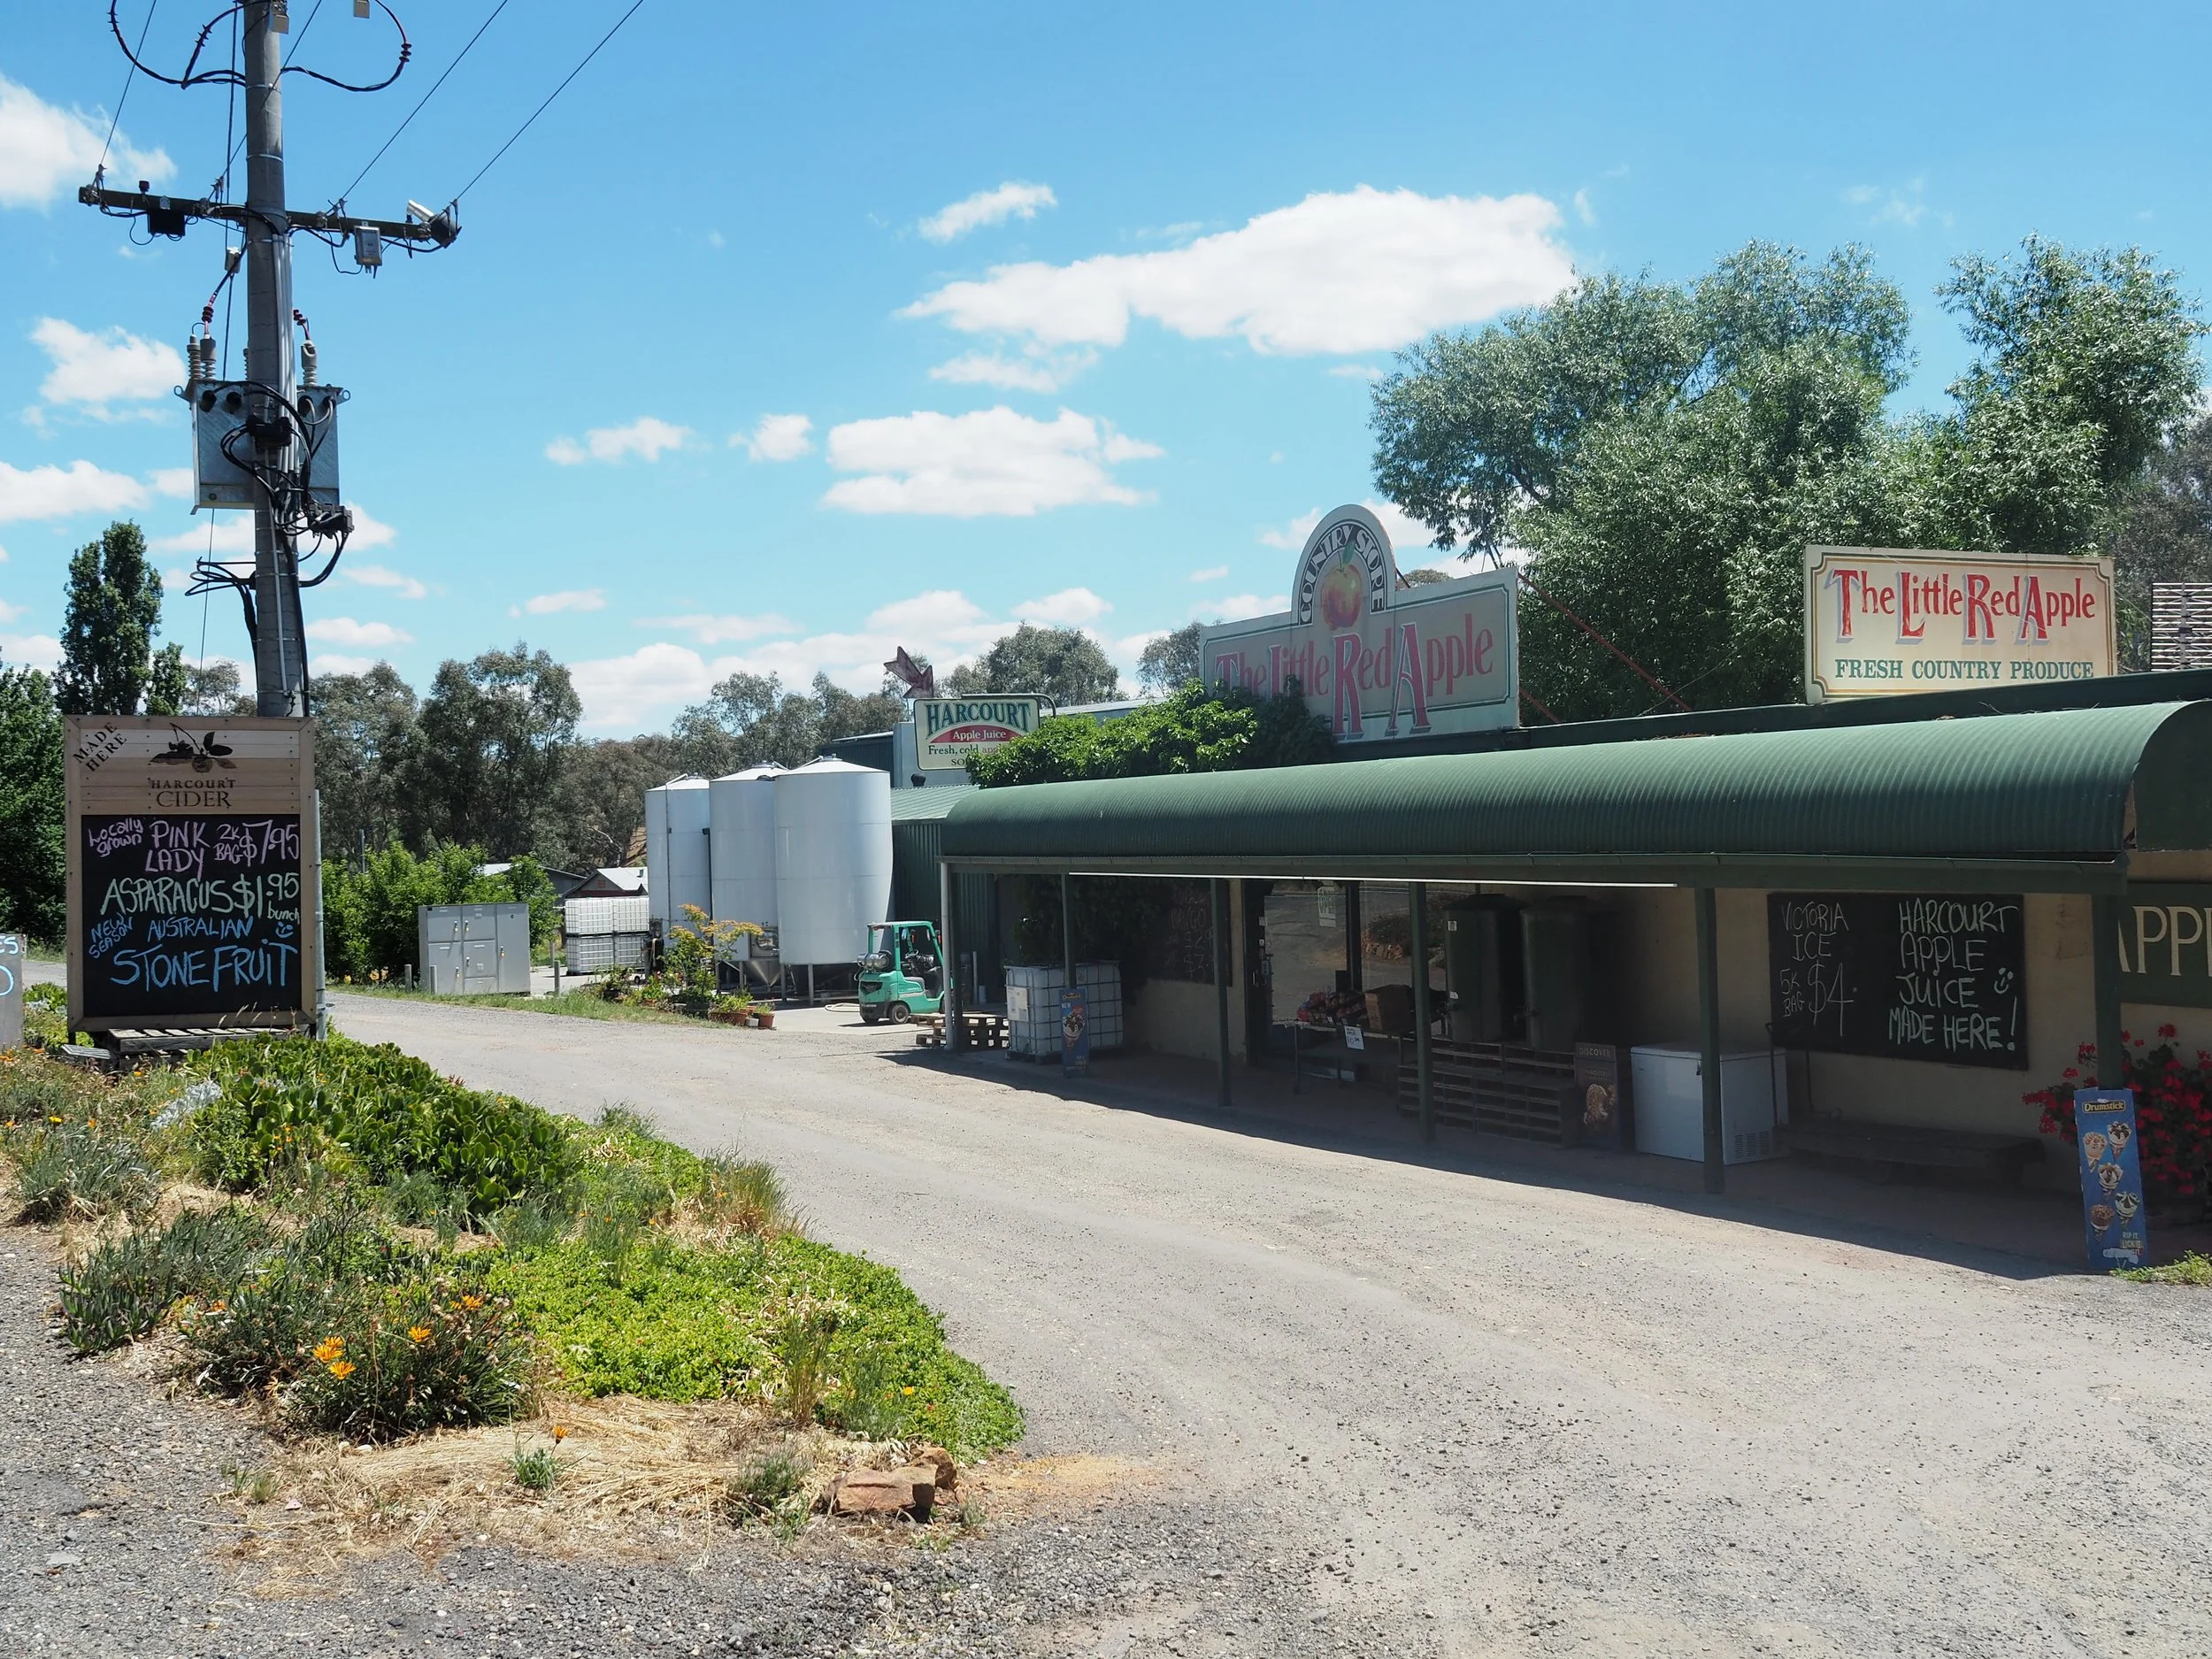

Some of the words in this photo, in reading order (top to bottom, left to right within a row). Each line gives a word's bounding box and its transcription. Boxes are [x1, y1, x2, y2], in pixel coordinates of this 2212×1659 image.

[1301, 525, 1353, 622] COUNTRY
[1355, 528, 1385, 611] STORE
[1826, 570, 1894, 637] The
[1901, 572, 1962, 637] Little
[1966, 574, 2019, 638] Red
[2021, 576, 2095, 639] Apple
[1333, 627, 1393, 738] Red
[1386, 613, 1494, 734] Apple
[1835, 659, 1902, 679] FRESH
[1911, 660, 2001, 680] COUNTRY
[2009, 661, 2093, 680] PRODUCE
[925, 703, 1033, 738] HARCOURT
[953, 730, 979, 741] Apple
[982, 729, 1006, 740] Juice
[73, 721, 118, 764] MADE
[86, 733, 127, 772] HERE
[928, 745, 957, 755] Fresh,
[959, 744, 979, 754] cold
[150, 780, 236, 789] HARCOURT
[156, 791, 232, 808] CIDER
[96, 833, 142, 857] grown
[145, 847, 204, 882] LADY
[213, 842, 245, 864] BAG
[149, 820, 211, 849] PINK
[217, 824, 241, 840] 2K
[239, 819, 300, 867] $7.95
[232, 872, 300, 918] $1.95
[266, 901, 300, 925] bunch
[147, 915, 253, 942] AUSTRALIAN
[1781, 902, 1849, 932] VICTORIA
[1898, 897, 2018, 933] HARCOURT
[88, 916, 133, 958] SEASON
[1792, 932, 1837, 962] ICE
[1901, 932, 1987, 972] APPLE
[2118, 906, 2212, 977] PP
[110, 943, 211, 992] STONE
[1779, 968, 1801, 995] 5K
[1783, 991, 1804, 1018] BAG
[1889, 1007, 1936, 1045] MADE
[2084, 1102, 2124, 1113] Drumstick
